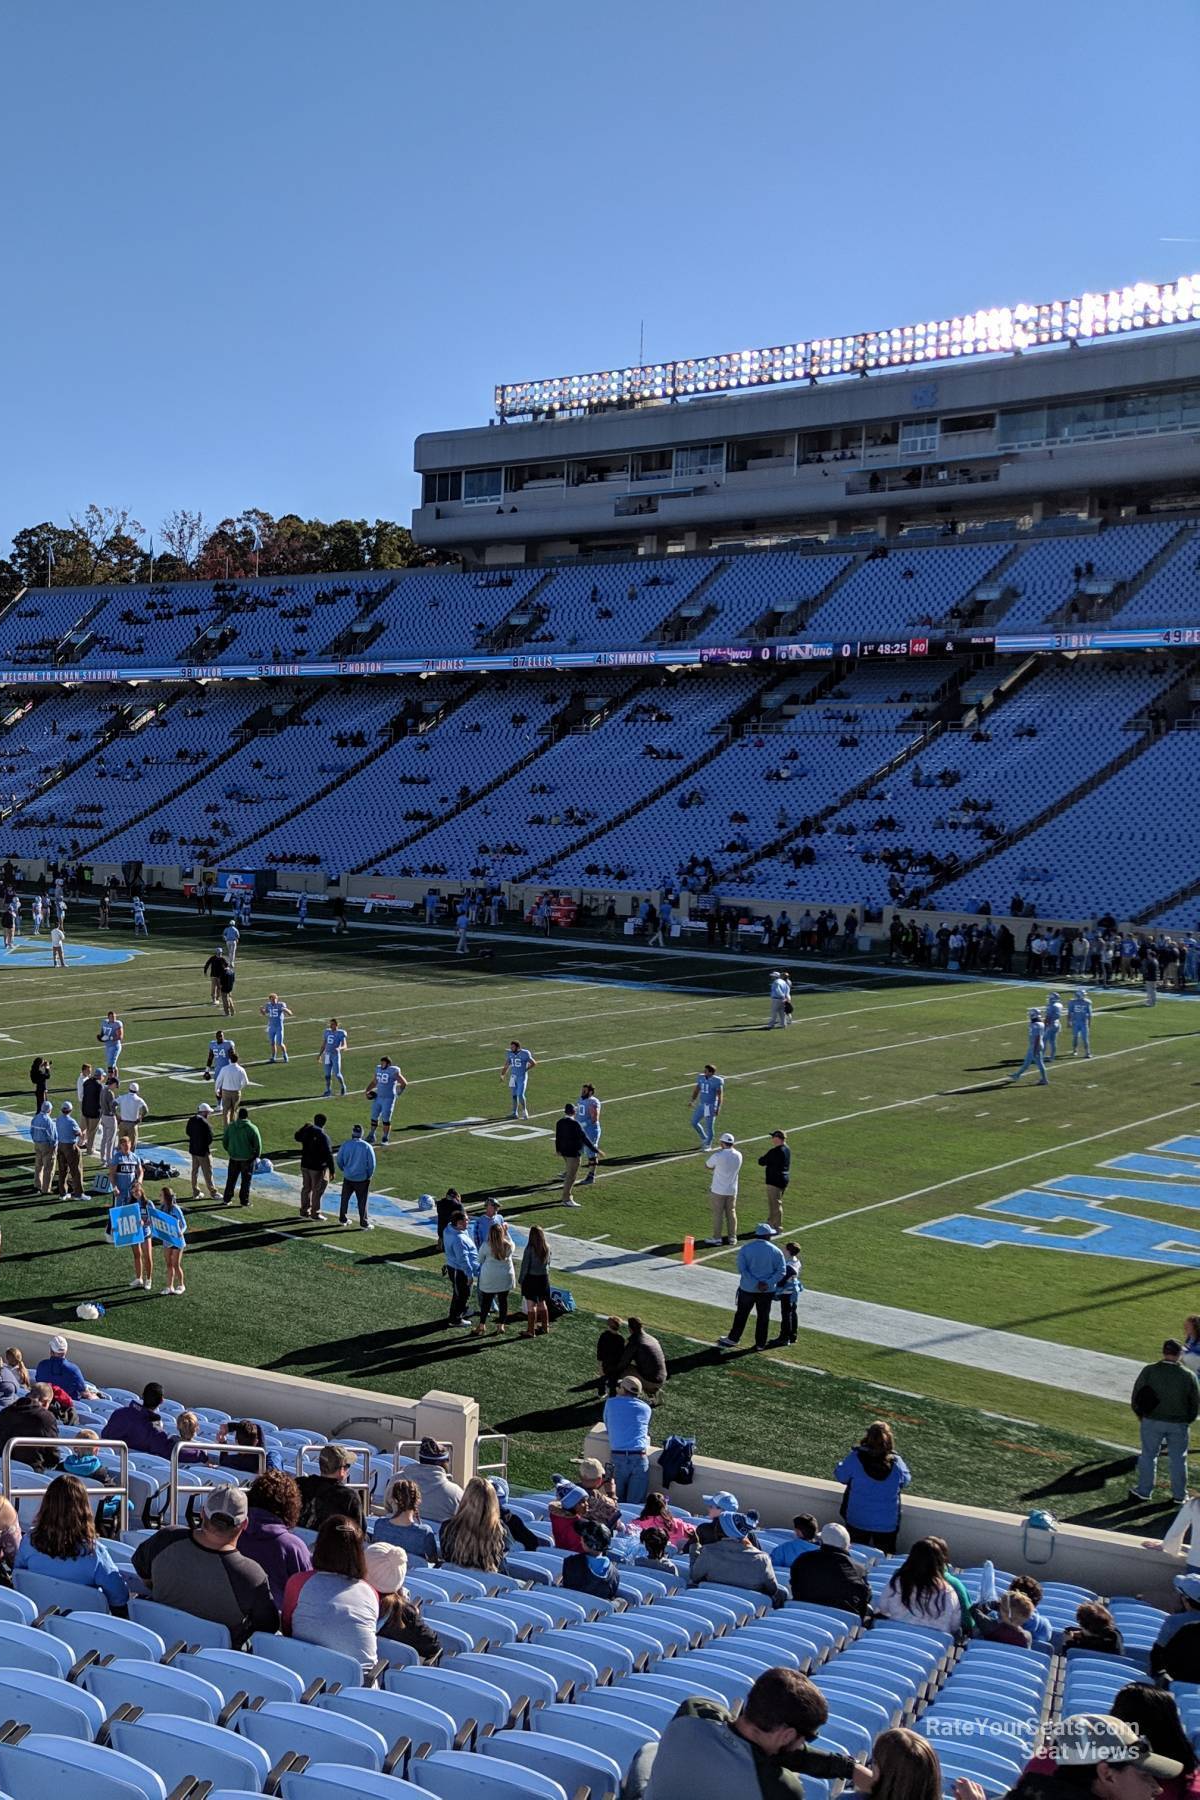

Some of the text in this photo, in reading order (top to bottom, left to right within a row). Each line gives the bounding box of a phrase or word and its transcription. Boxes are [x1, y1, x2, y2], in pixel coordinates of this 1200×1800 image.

[1071, 634, 1092, 647] BLY
[1163, 630, 1182, 642] 49
[731, 649, 752, 659] WCU
[761, 647, 770, 660] 0
[813, 647, 833, 657] UNC
[842, 644, 850, 657] 0
[877, 643, 907, 654] 48:25
[913, 643, 926, 652] 40
[946, 642, 953, 650] &
[513, 655, 552, 667] 87 ELLIS
[596, 652, 656, 665] 41 SIMMONS
[349, 663, 381, 673] HORTON
[436, 660, 464, 670] JONES
[2, 670, 118, 681] WELCOME TO KENAN STADIUM
[181, 668, 221, 678] 98 TAYLOR
[258, 666, 299, 676] 95 FULLER
[268, 1008, 279, 1018] 15
[103, 1026, 113, 1036] 77
[327, 1034, 334, 1044] 6
[212, 1048, 226, 1059] 54
[511, 1058, 522, 1068] 16
[701, 1083, 709, 1094] 11
[96, 1174, 109, 1190] 10
[118, 1214, 138, 1237] TAR
